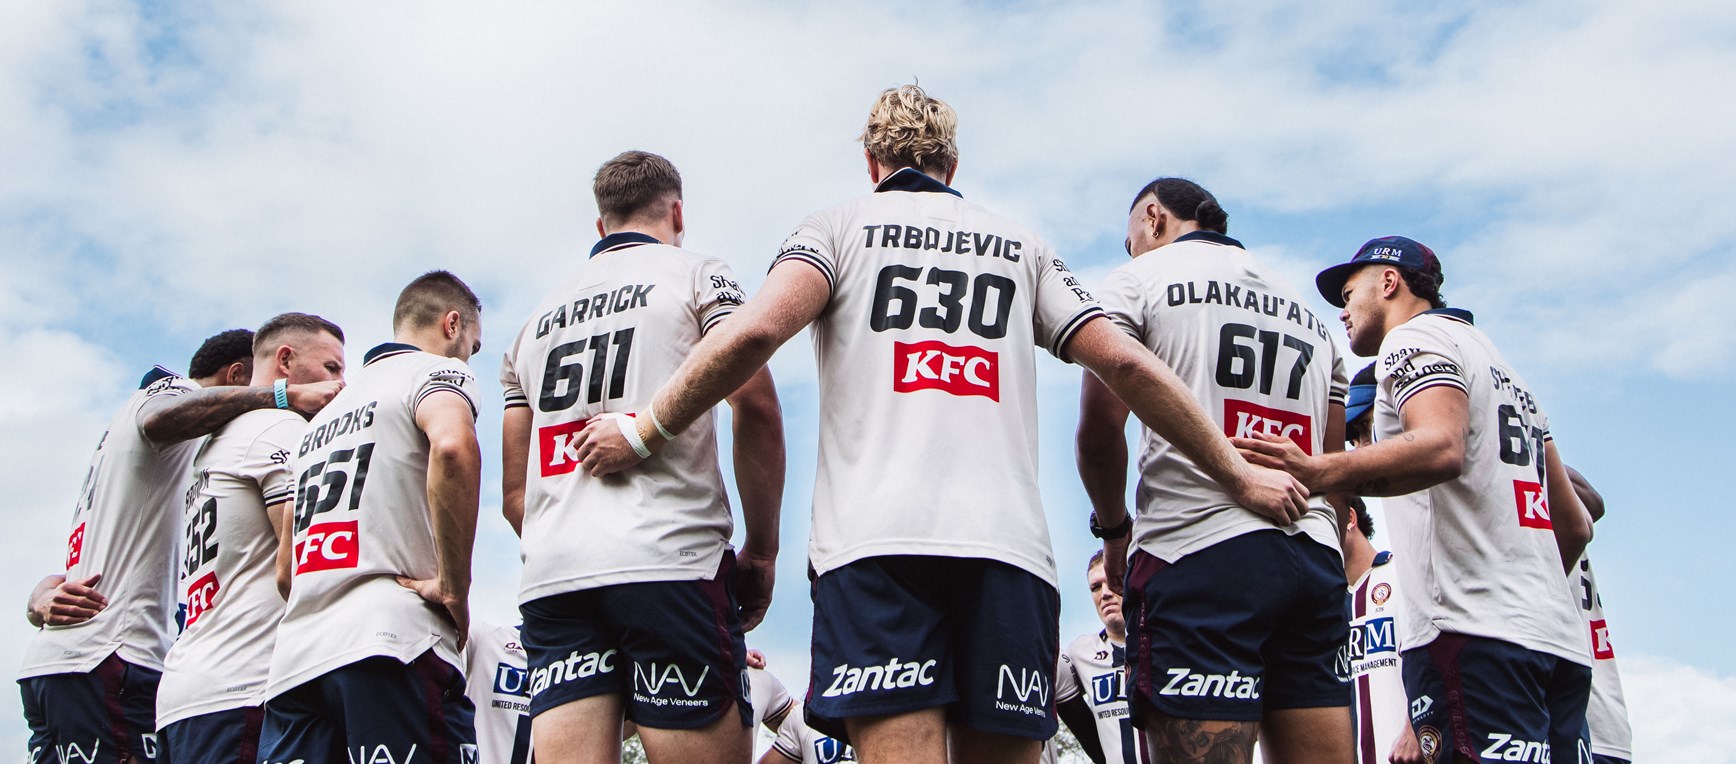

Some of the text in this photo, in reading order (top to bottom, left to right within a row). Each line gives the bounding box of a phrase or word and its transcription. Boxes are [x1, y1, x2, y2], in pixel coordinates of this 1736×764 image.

[862, 224, 1022, 263] TRBOJEVIC
[1374, 247, 1402, 257] URM
[536, 284, 656, 340] GARRICK
[870, 264, 1016, 340] 630
[538, 327, 636, 413] 611
[901, 350, 992, 388] KFC
[1215, 323, 1314, 400] 617
[298, 400, 378, 459] BROOKS
[294, 442, 376, 537] 651
[298, 531, 352, 566] FC
[1349, 621, 1395, 658] RM
[634, 661, 709, 697] NAV
[822, 657, 937, 698] Zantac
[634, 693, 709, 707] New Age Veneers
[996, 701, 1018, 711] New
[1019, 704, 1033, 714] Age
